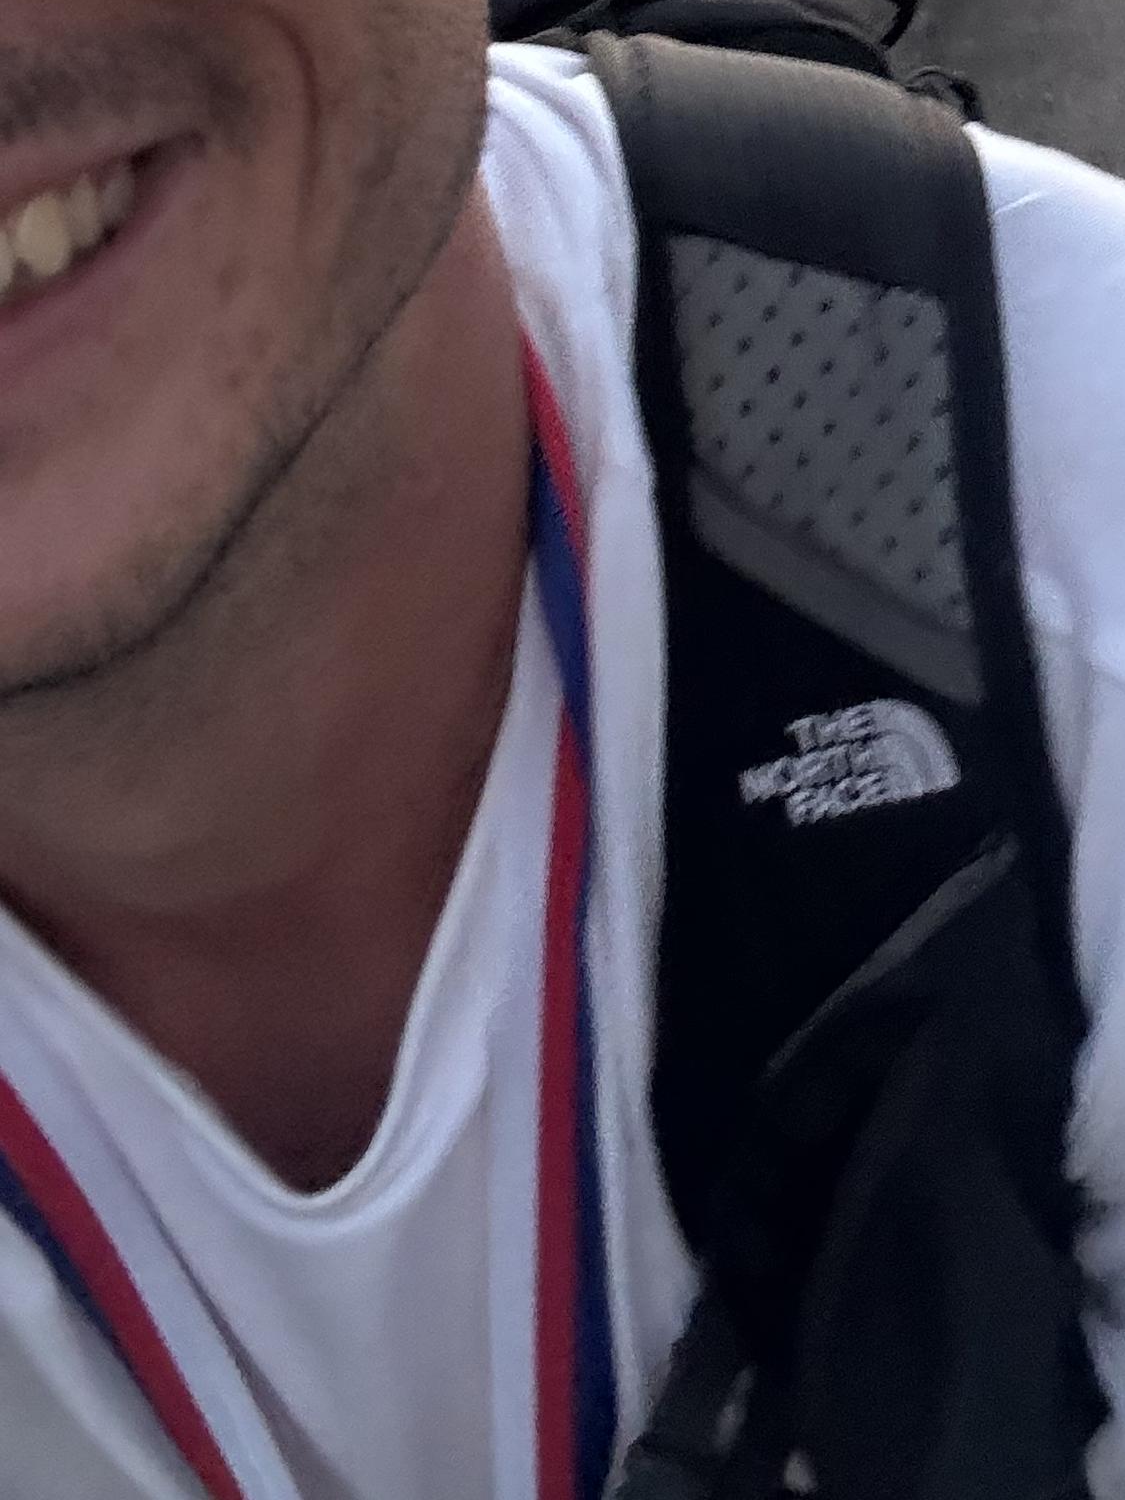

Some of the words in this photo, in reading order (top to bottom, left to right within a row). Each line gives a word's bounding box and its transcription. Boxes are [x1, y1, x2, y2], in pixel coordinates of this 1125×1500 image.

[784, 704, 876, 752] THE
[738, 740, 882, 804] NORTH
[785, 770, 890, 827] FACE
